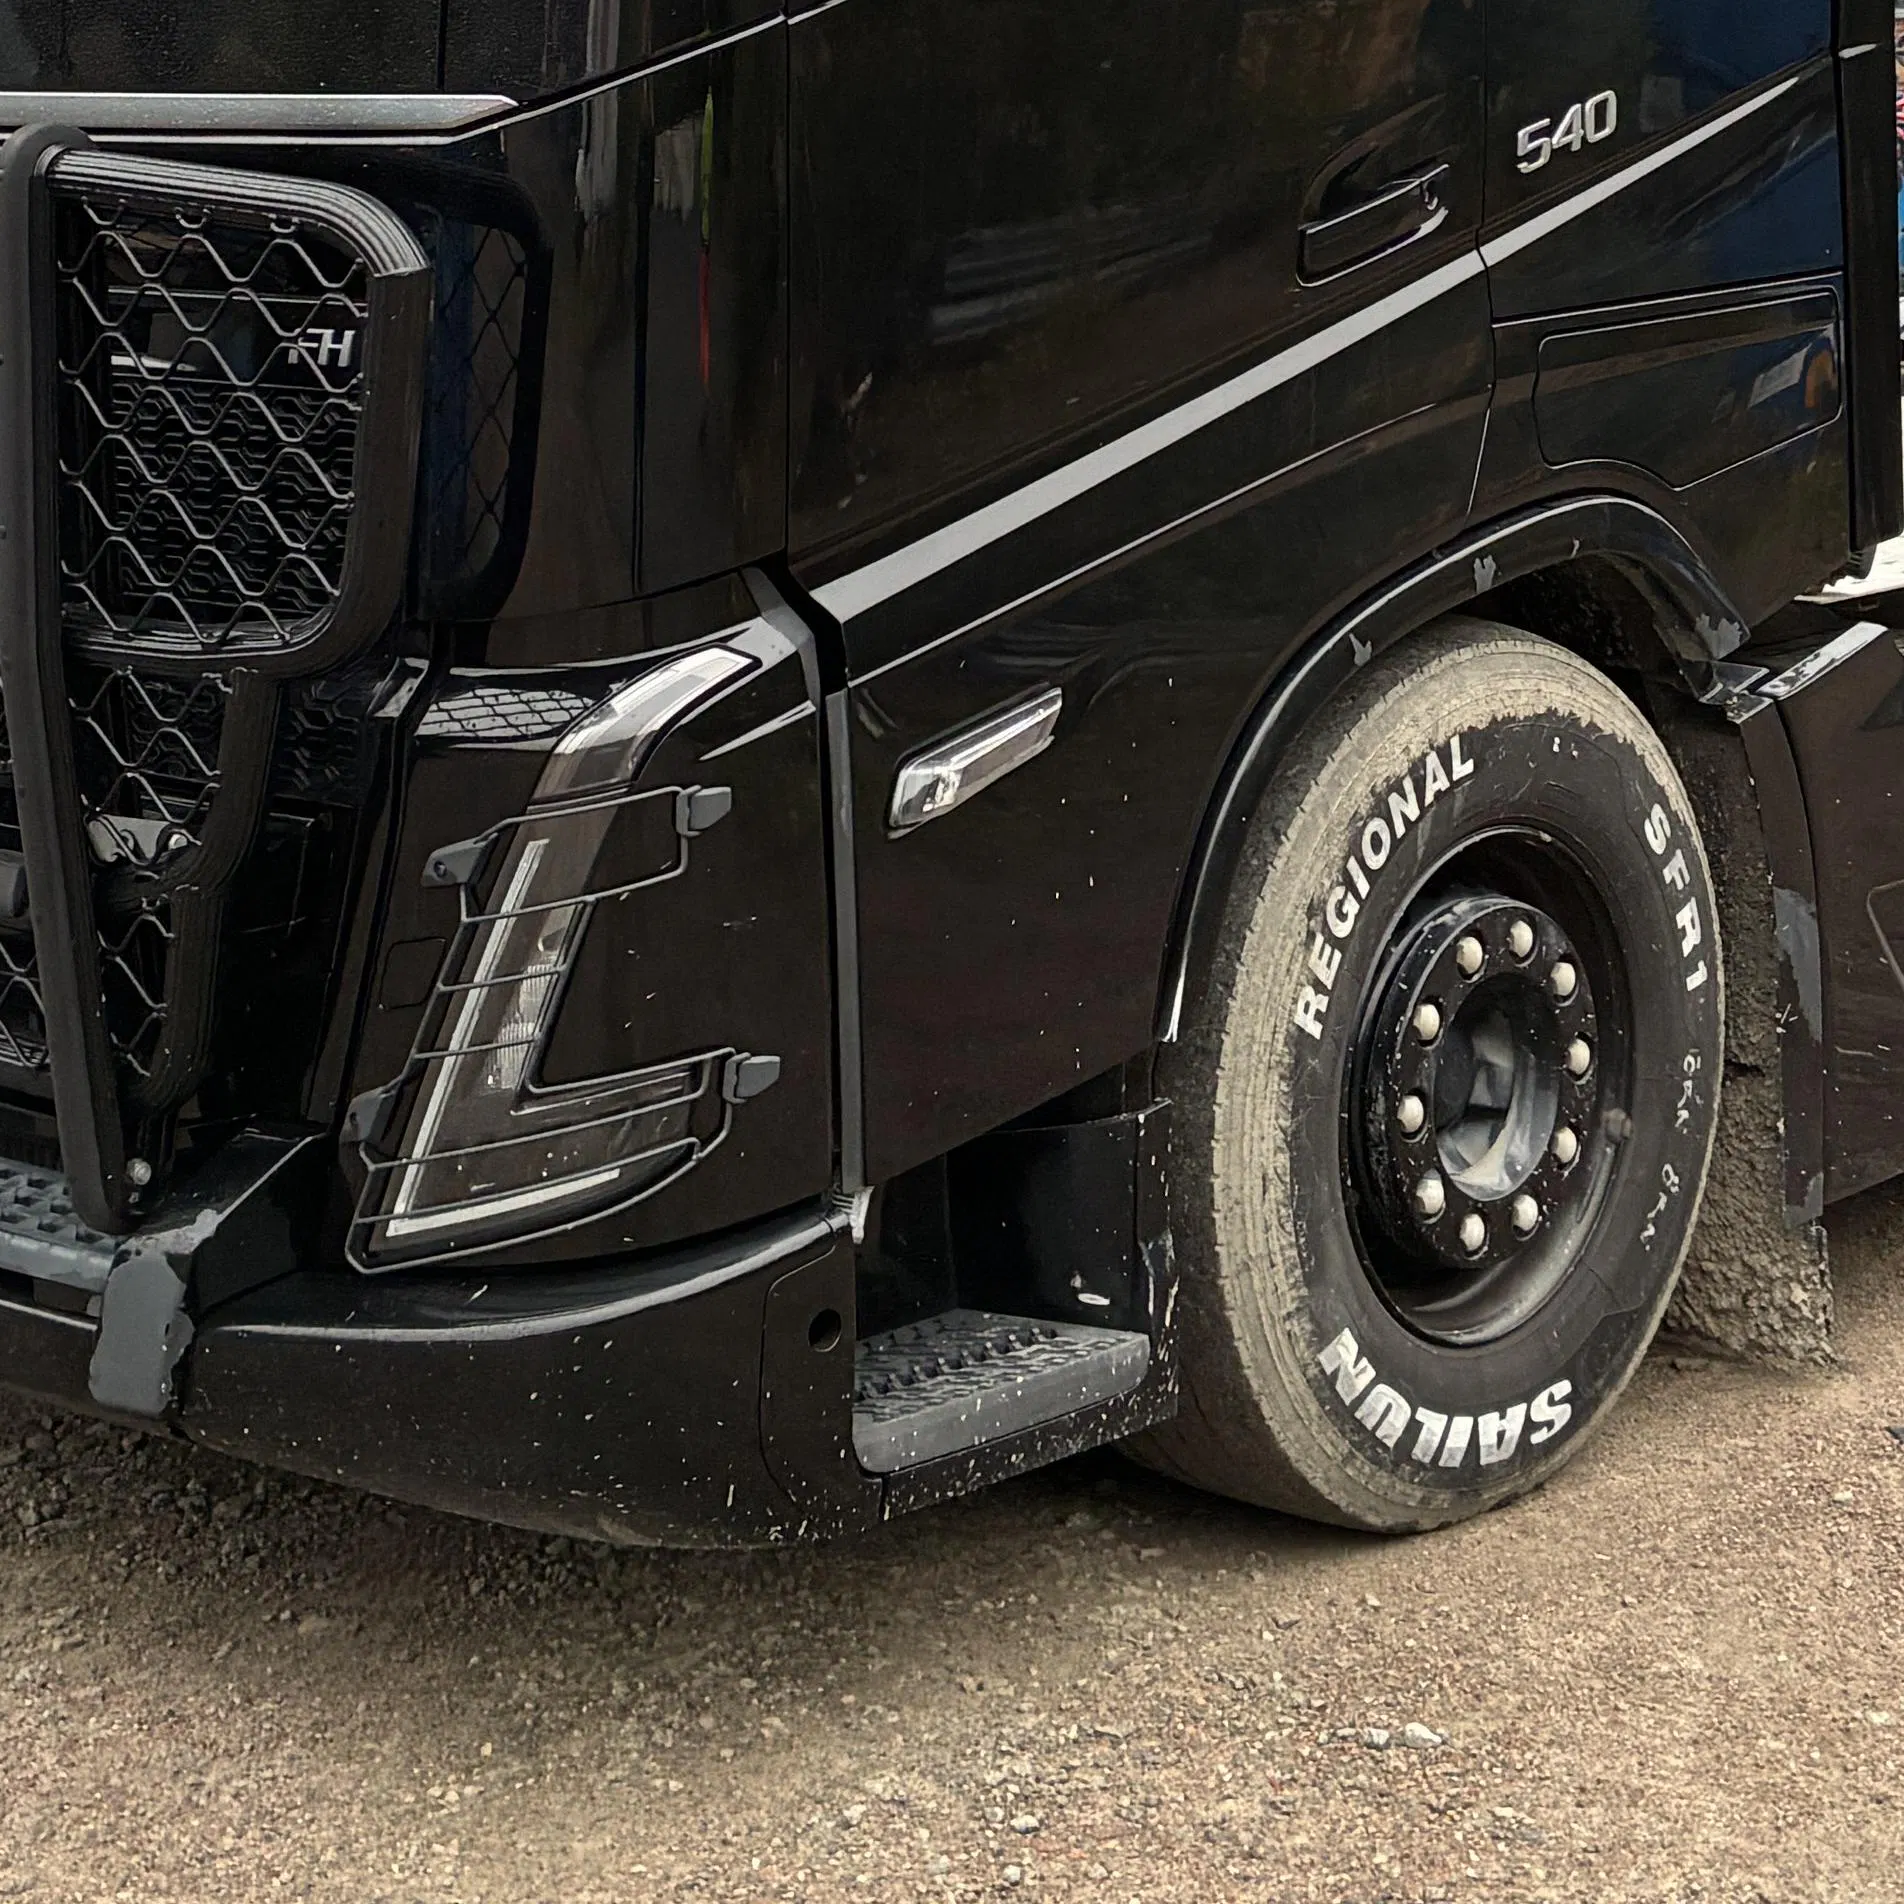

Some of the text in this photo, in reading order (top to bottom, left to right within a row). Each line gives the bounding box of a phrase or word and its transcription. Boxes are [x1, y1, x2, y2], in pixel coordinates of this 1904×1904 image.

[1516, 89, 1618, 174] 540
[1293, 734, 1477, 1041] REGIONAL
[1643, 802, 1708, 992] SFR1
[1315, 1326, 1574, 1469] SAILUN
